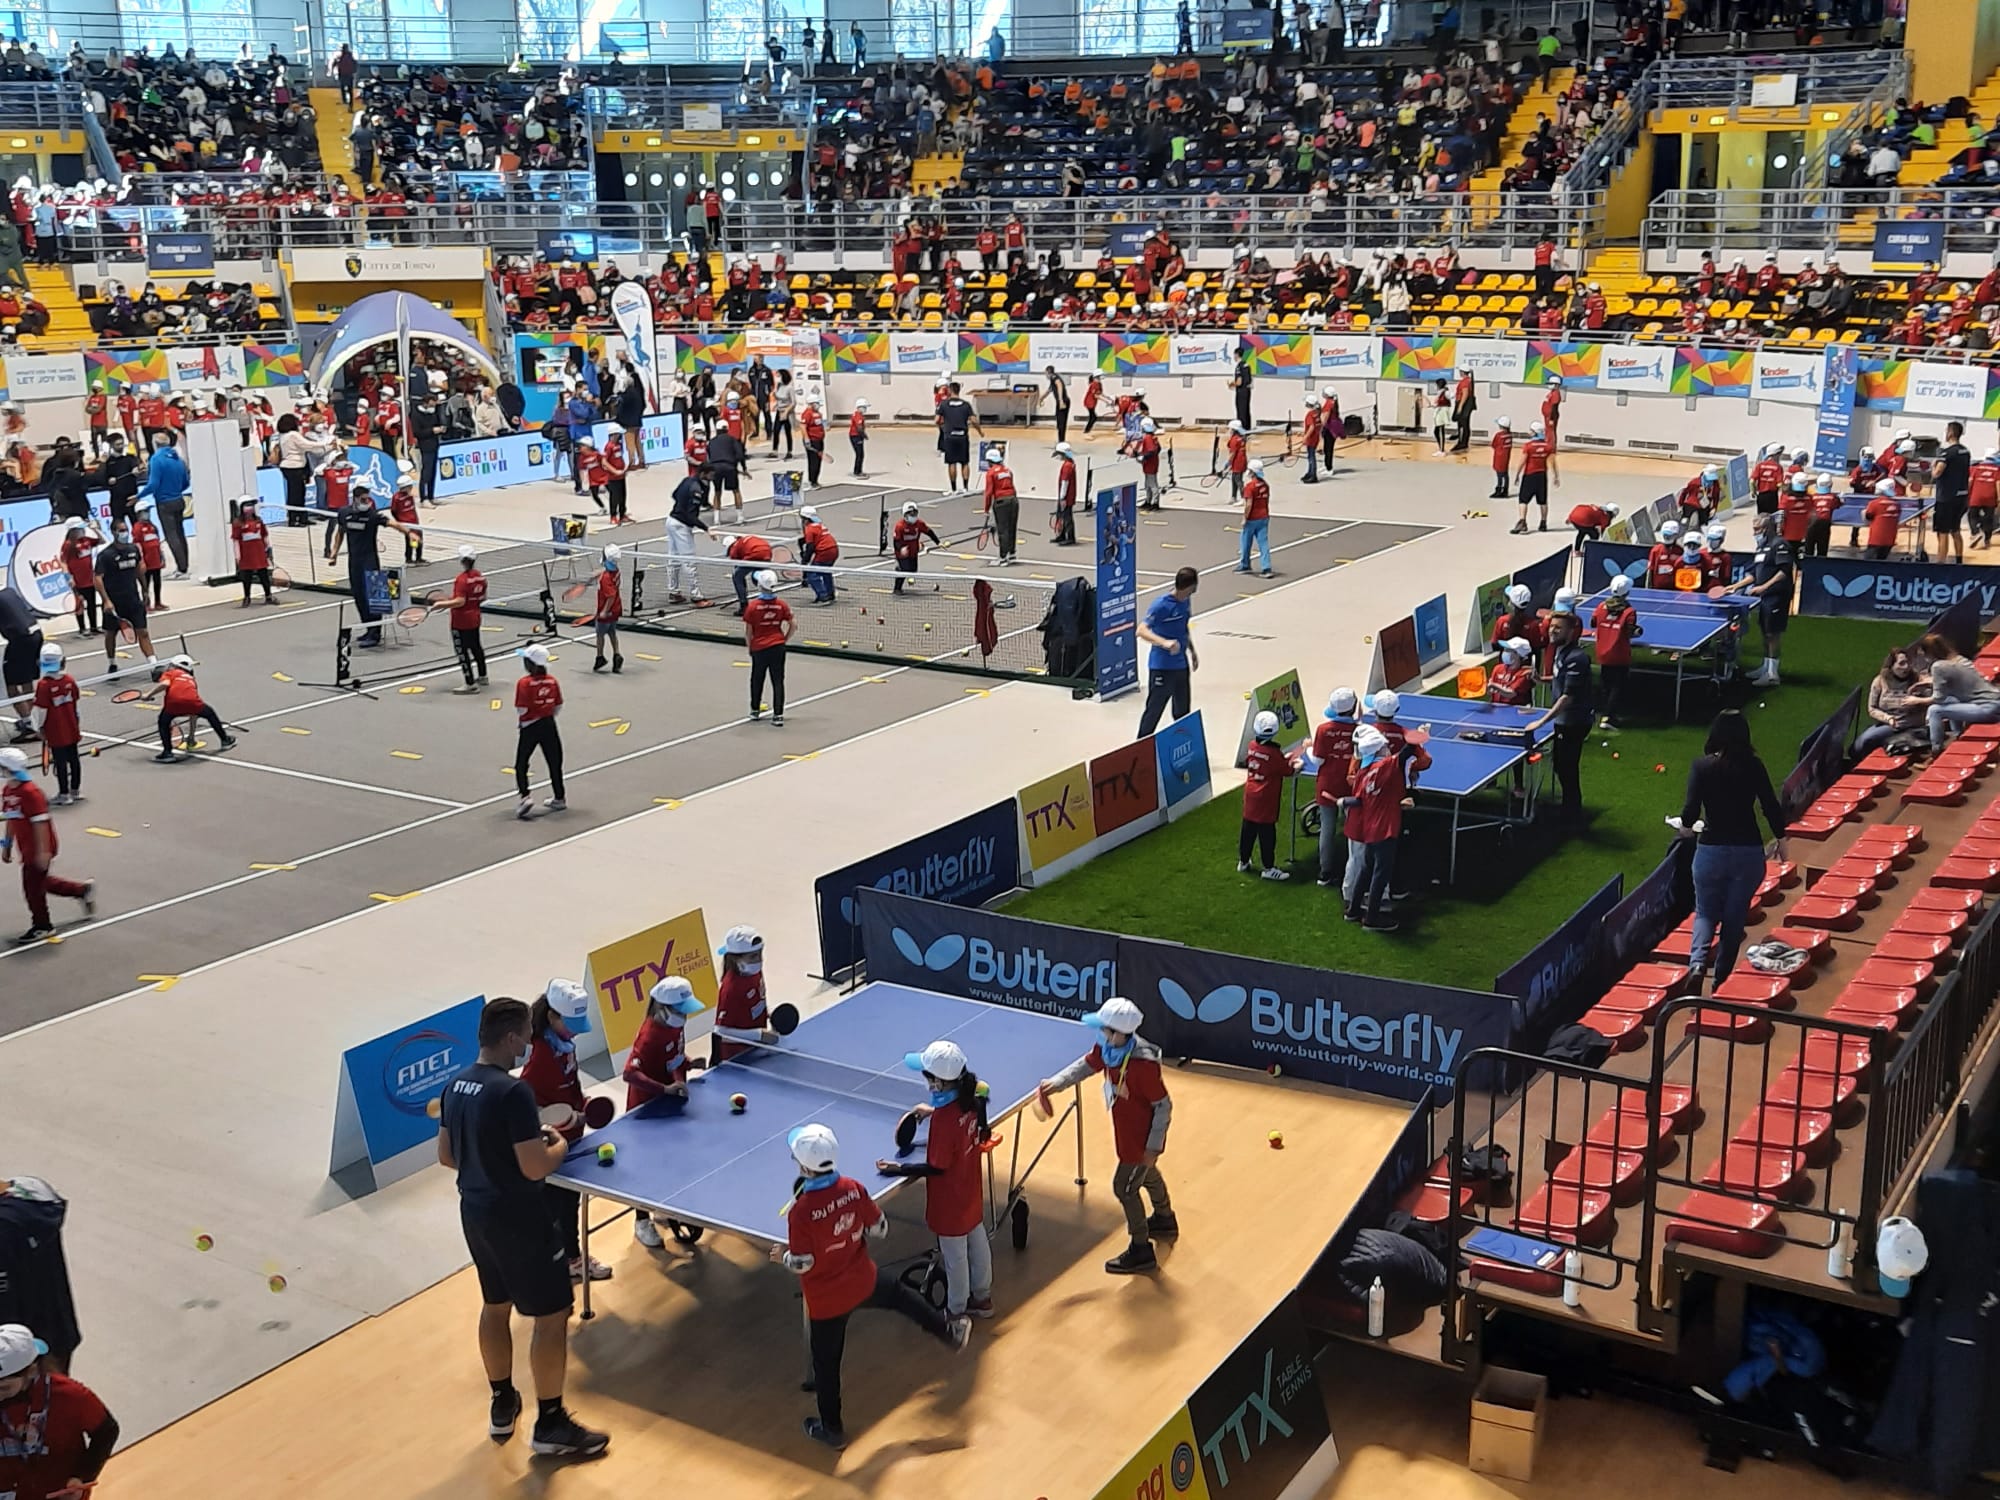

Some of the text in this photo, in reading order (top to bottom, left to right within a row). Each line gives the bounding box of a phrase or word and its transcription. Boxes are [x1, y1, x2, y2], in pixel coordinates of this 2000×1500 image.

[1875, 575, 1998, 610] Butterfy
[1094, 756, 1140, 806] TTX
[1025, 783, 1076, 839] TTX
[893, 835, 996, 897] Butterfly
[968, 937, 1117, 1005] Butterfl
[1251, 987, 1464, 1074] Butterfly
[397, 1047, 453, 1087] FITET
[453, 1080, 484, 1097] STAFF
[1276, 1354, 1304, 1390] TABLE
[1280, 1364, 1313, 1406] TENNIS
[1202, 1347, 1294, 1488] TTX
